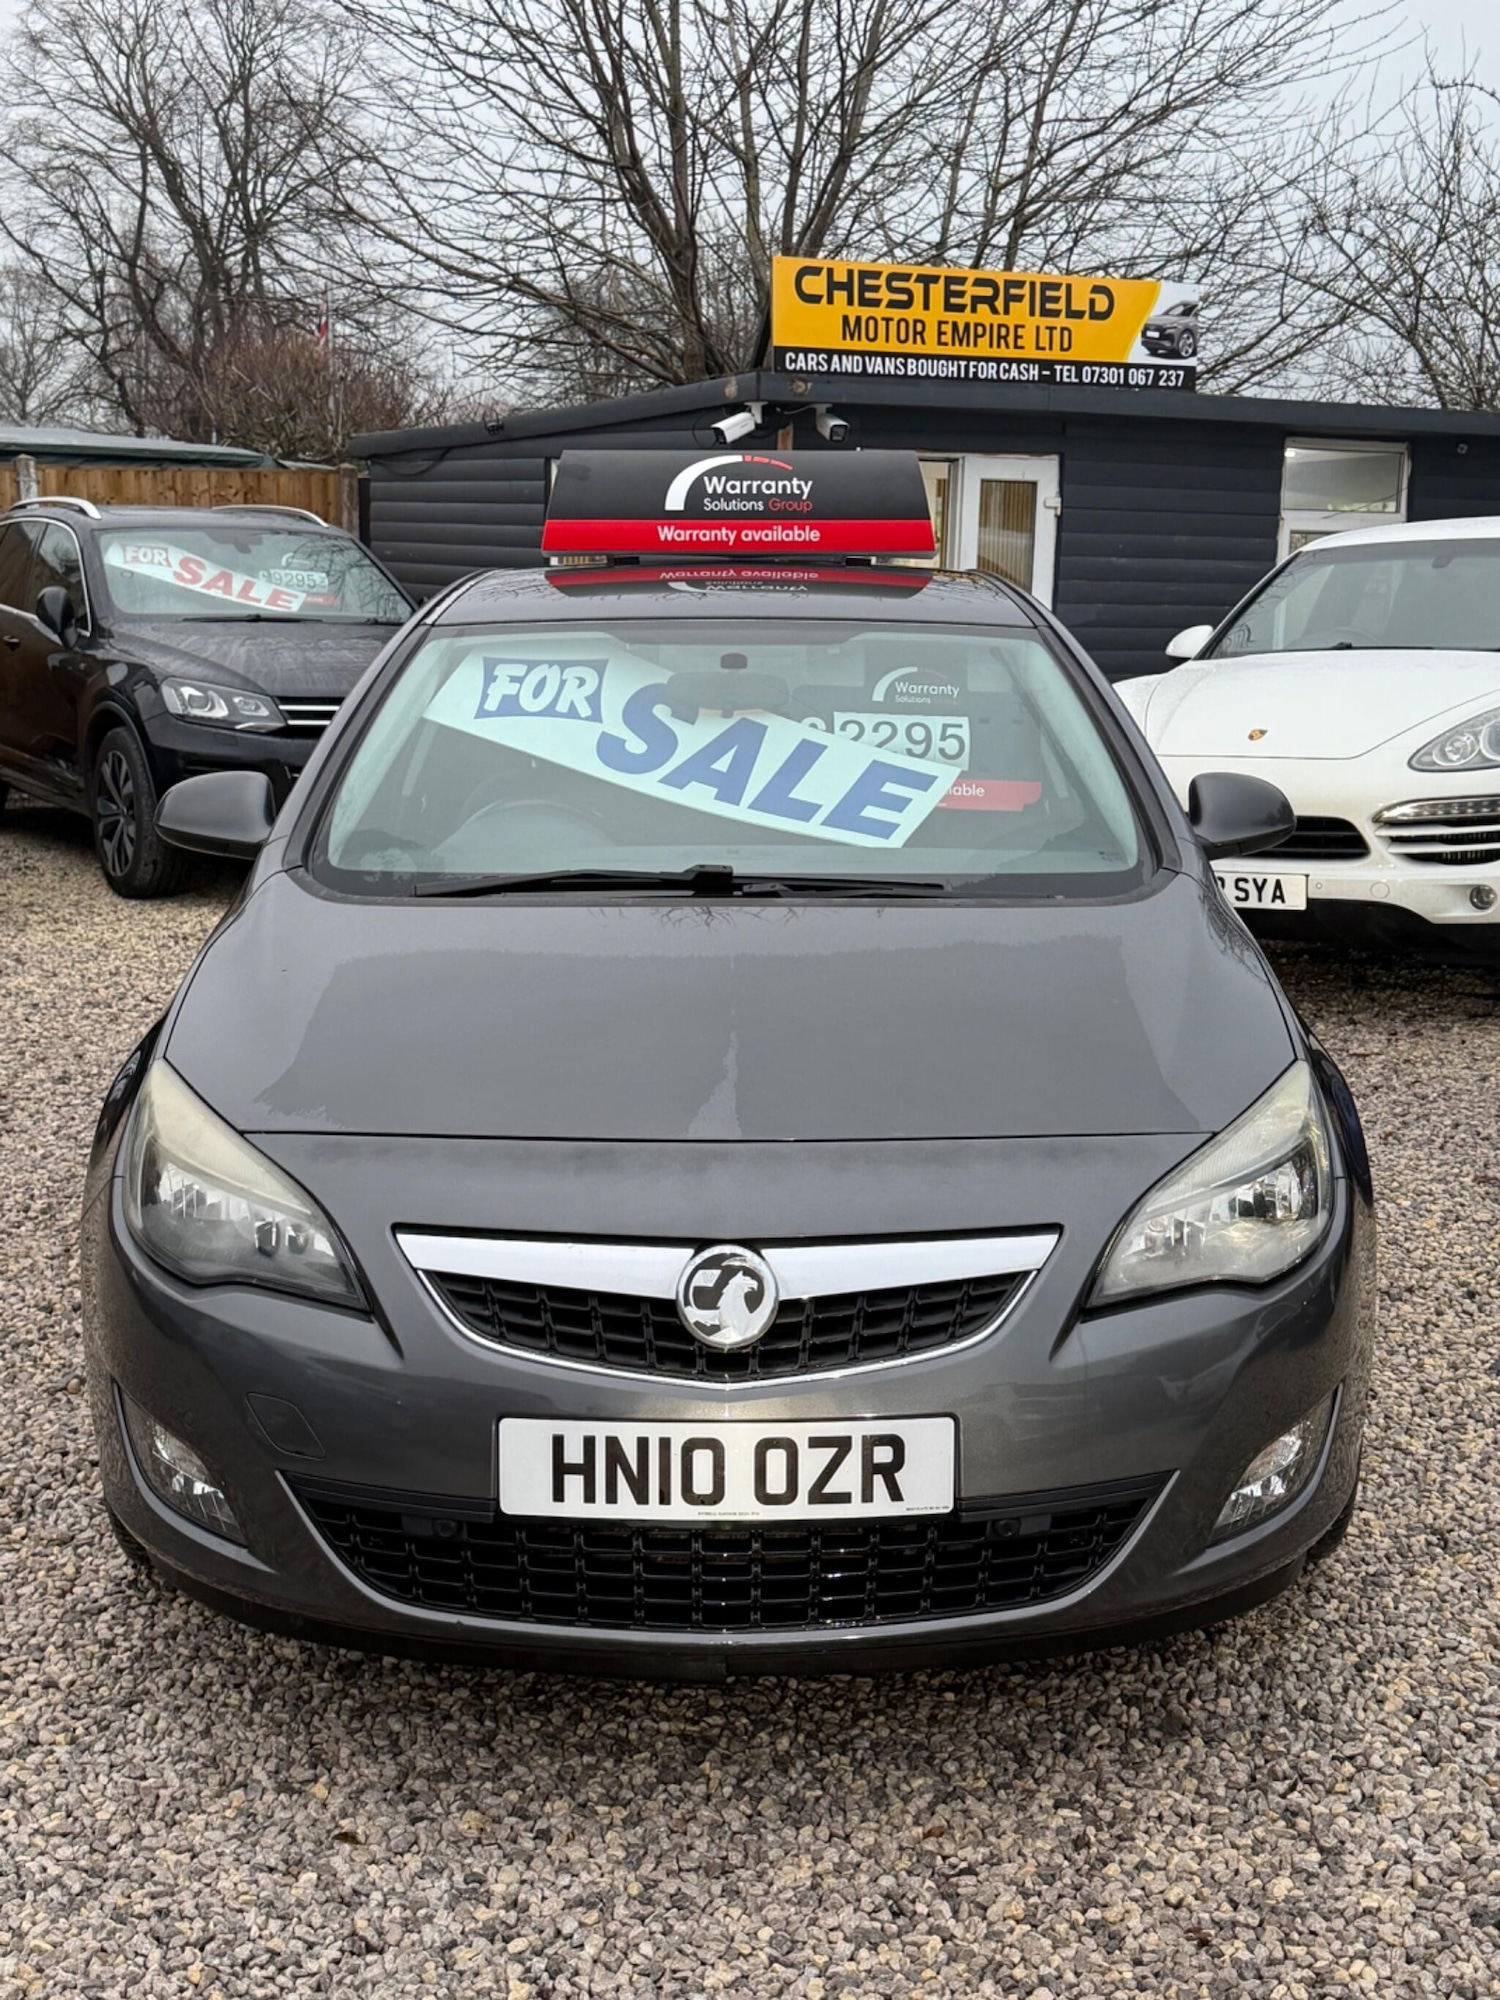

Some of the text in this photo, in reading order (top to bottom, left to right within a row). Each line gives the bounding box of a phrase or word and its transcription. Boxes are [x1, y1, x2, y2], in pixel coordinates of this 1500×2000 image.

[794, 265, 1115, 321] CHESTERFIELD
[841, 315, 1073, 353] MOTOR EMPIRE LTD
[785, 352, 828, 373] CARS
[829, 354, 863, 374] AND
[864, 355, 906, 376] VANS
[907, 358, 968, 379] BOUGHT
[970, 360, 999, 380] FOR
[1000, 363, 1039, 381] CASH
[1054, 365, 1079, 383] TEL
[1082, 367, 1124, 385] 07301
[1128, 369, 1154, 386] 067
[1158, 371, 1185, 387] 237
[703, 475, 813, 500] Warranty
[703, 498, 813, 513] Solutions Group
[657, 526, 820, 545] Warranty available
[123, 545, 299, 610] FOR SALE
[895, 681, 960, 698] Warranty
[895, 694, 931, 704] Solutions
[483, 662, 939, 840] FOR SALE
[1234, 876, 1286, 904] SYA
[551, 1432, 906, 1507] HN10 OZR
